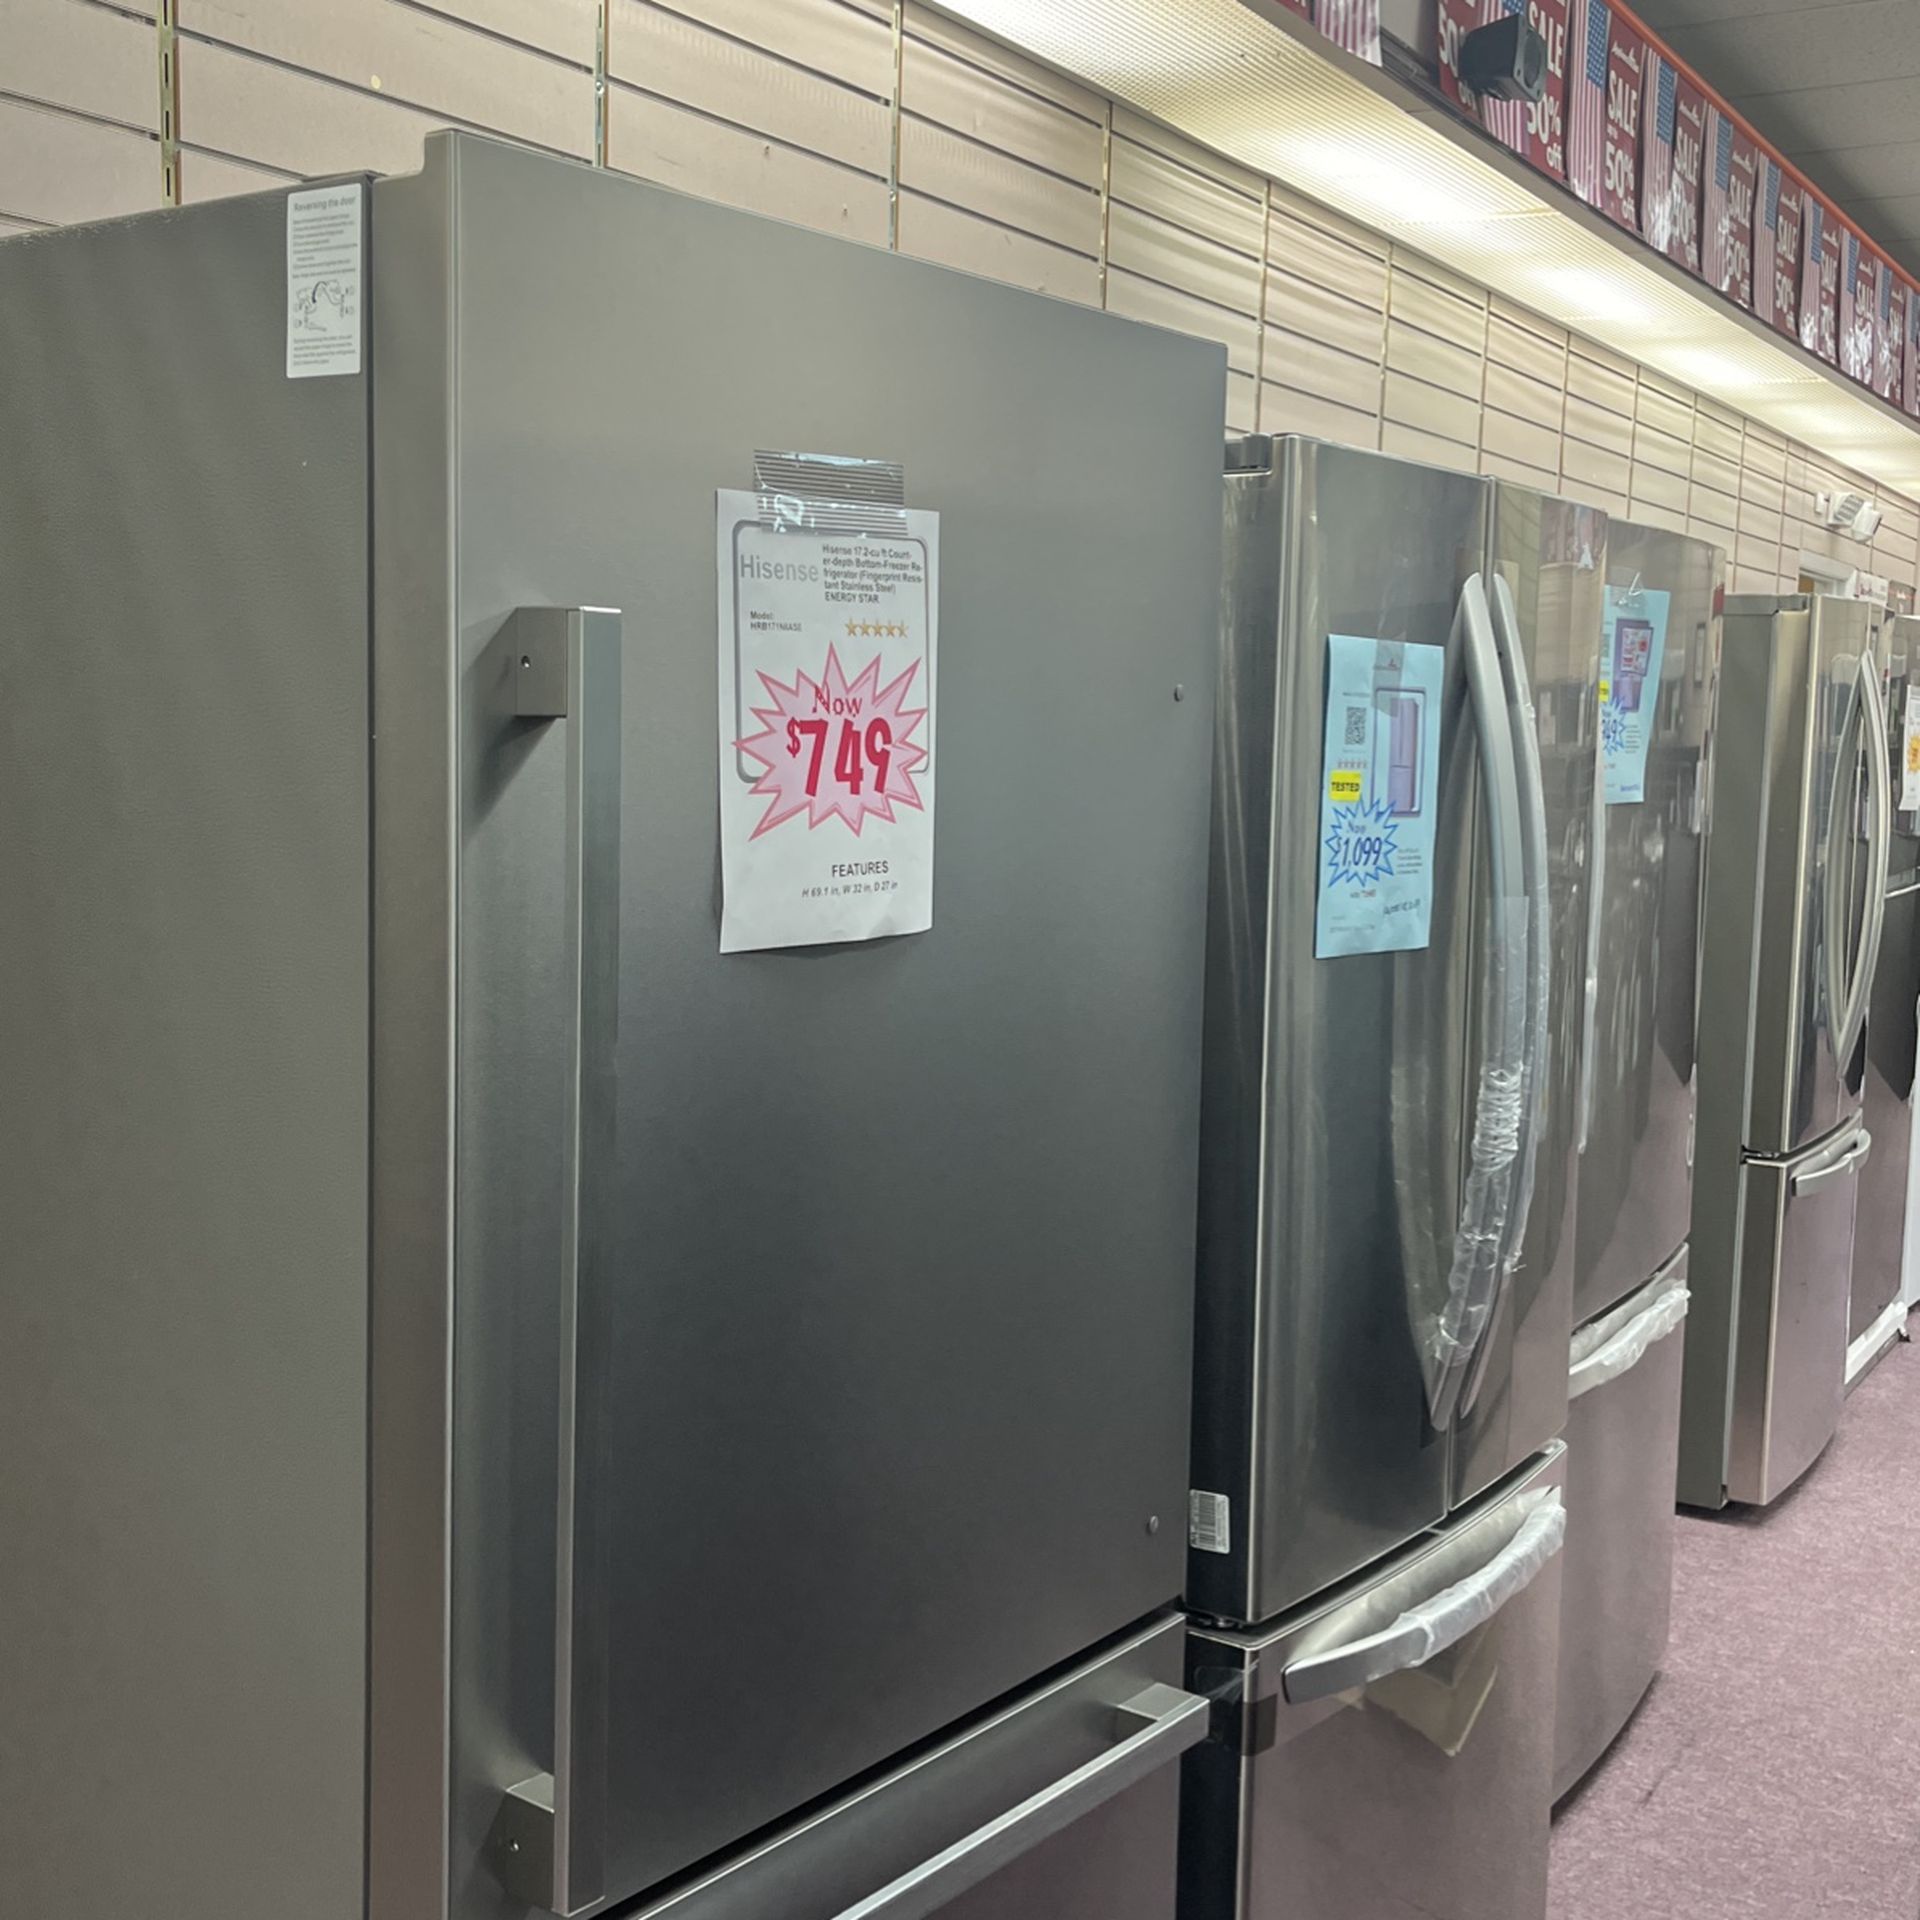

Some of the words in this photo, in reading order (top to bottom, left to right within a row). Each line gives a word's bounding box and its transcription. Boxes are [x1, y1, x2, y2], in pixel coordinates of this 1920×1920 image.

[1438, 0, 1469, 79] 50
[1608, 69, 1638, 138] SALE
[1546, 143, 1562, 173] off
[1604, 140, 1635, 199] 50%
[1674, 126, 1699, 187] SALE
[1621, 198, 1636, 225] off
[1729, 174, 1751, 229] SALE
[823, 544, 852, 556] Hisense
[740, 554, 819, 582] Hisense
[823, 568, 857, 580] frigerator
[824, 591, 856, 602] ENERGY
[858, 593, 880, 603] STAR
[841, 581, 873, 592] Stainless
[812, 685, 862, 717] Now
[786, 717, 892, 797] $749
[1331, 781, 1361, 792] TESTED
[831, 860, 889, 878] FEATURES
[802, 888, 809, 897] H
[842, 884, 851, 894] W
[874, 881, 881, 891] D
